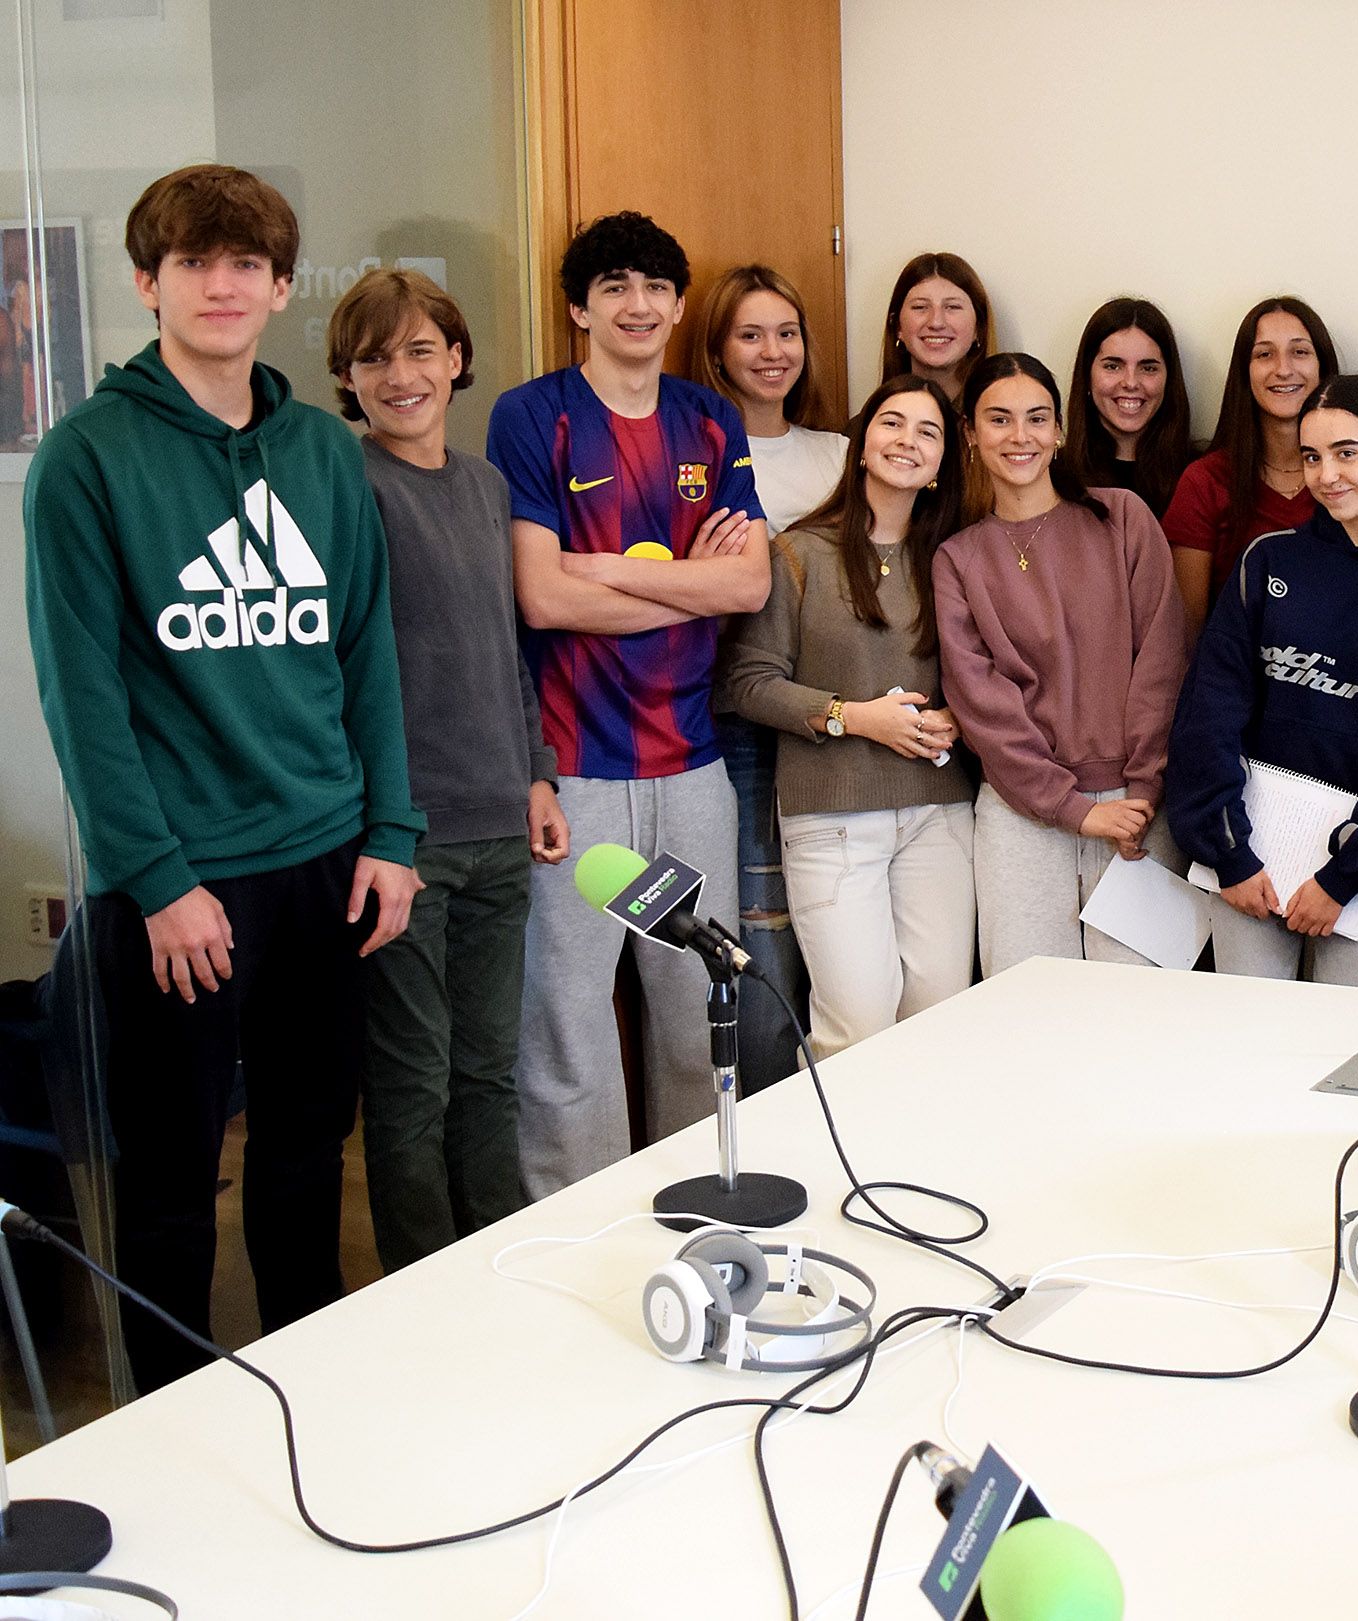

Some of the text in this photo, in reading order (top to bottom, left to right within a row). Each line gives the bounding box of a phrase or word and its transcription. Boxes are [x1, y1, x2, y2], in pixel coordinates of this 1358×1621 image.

[157, 586, 330, 651] adida
[638, 868, 675, 901] Pontevedra
[644, 890, 661, 904] Viva
